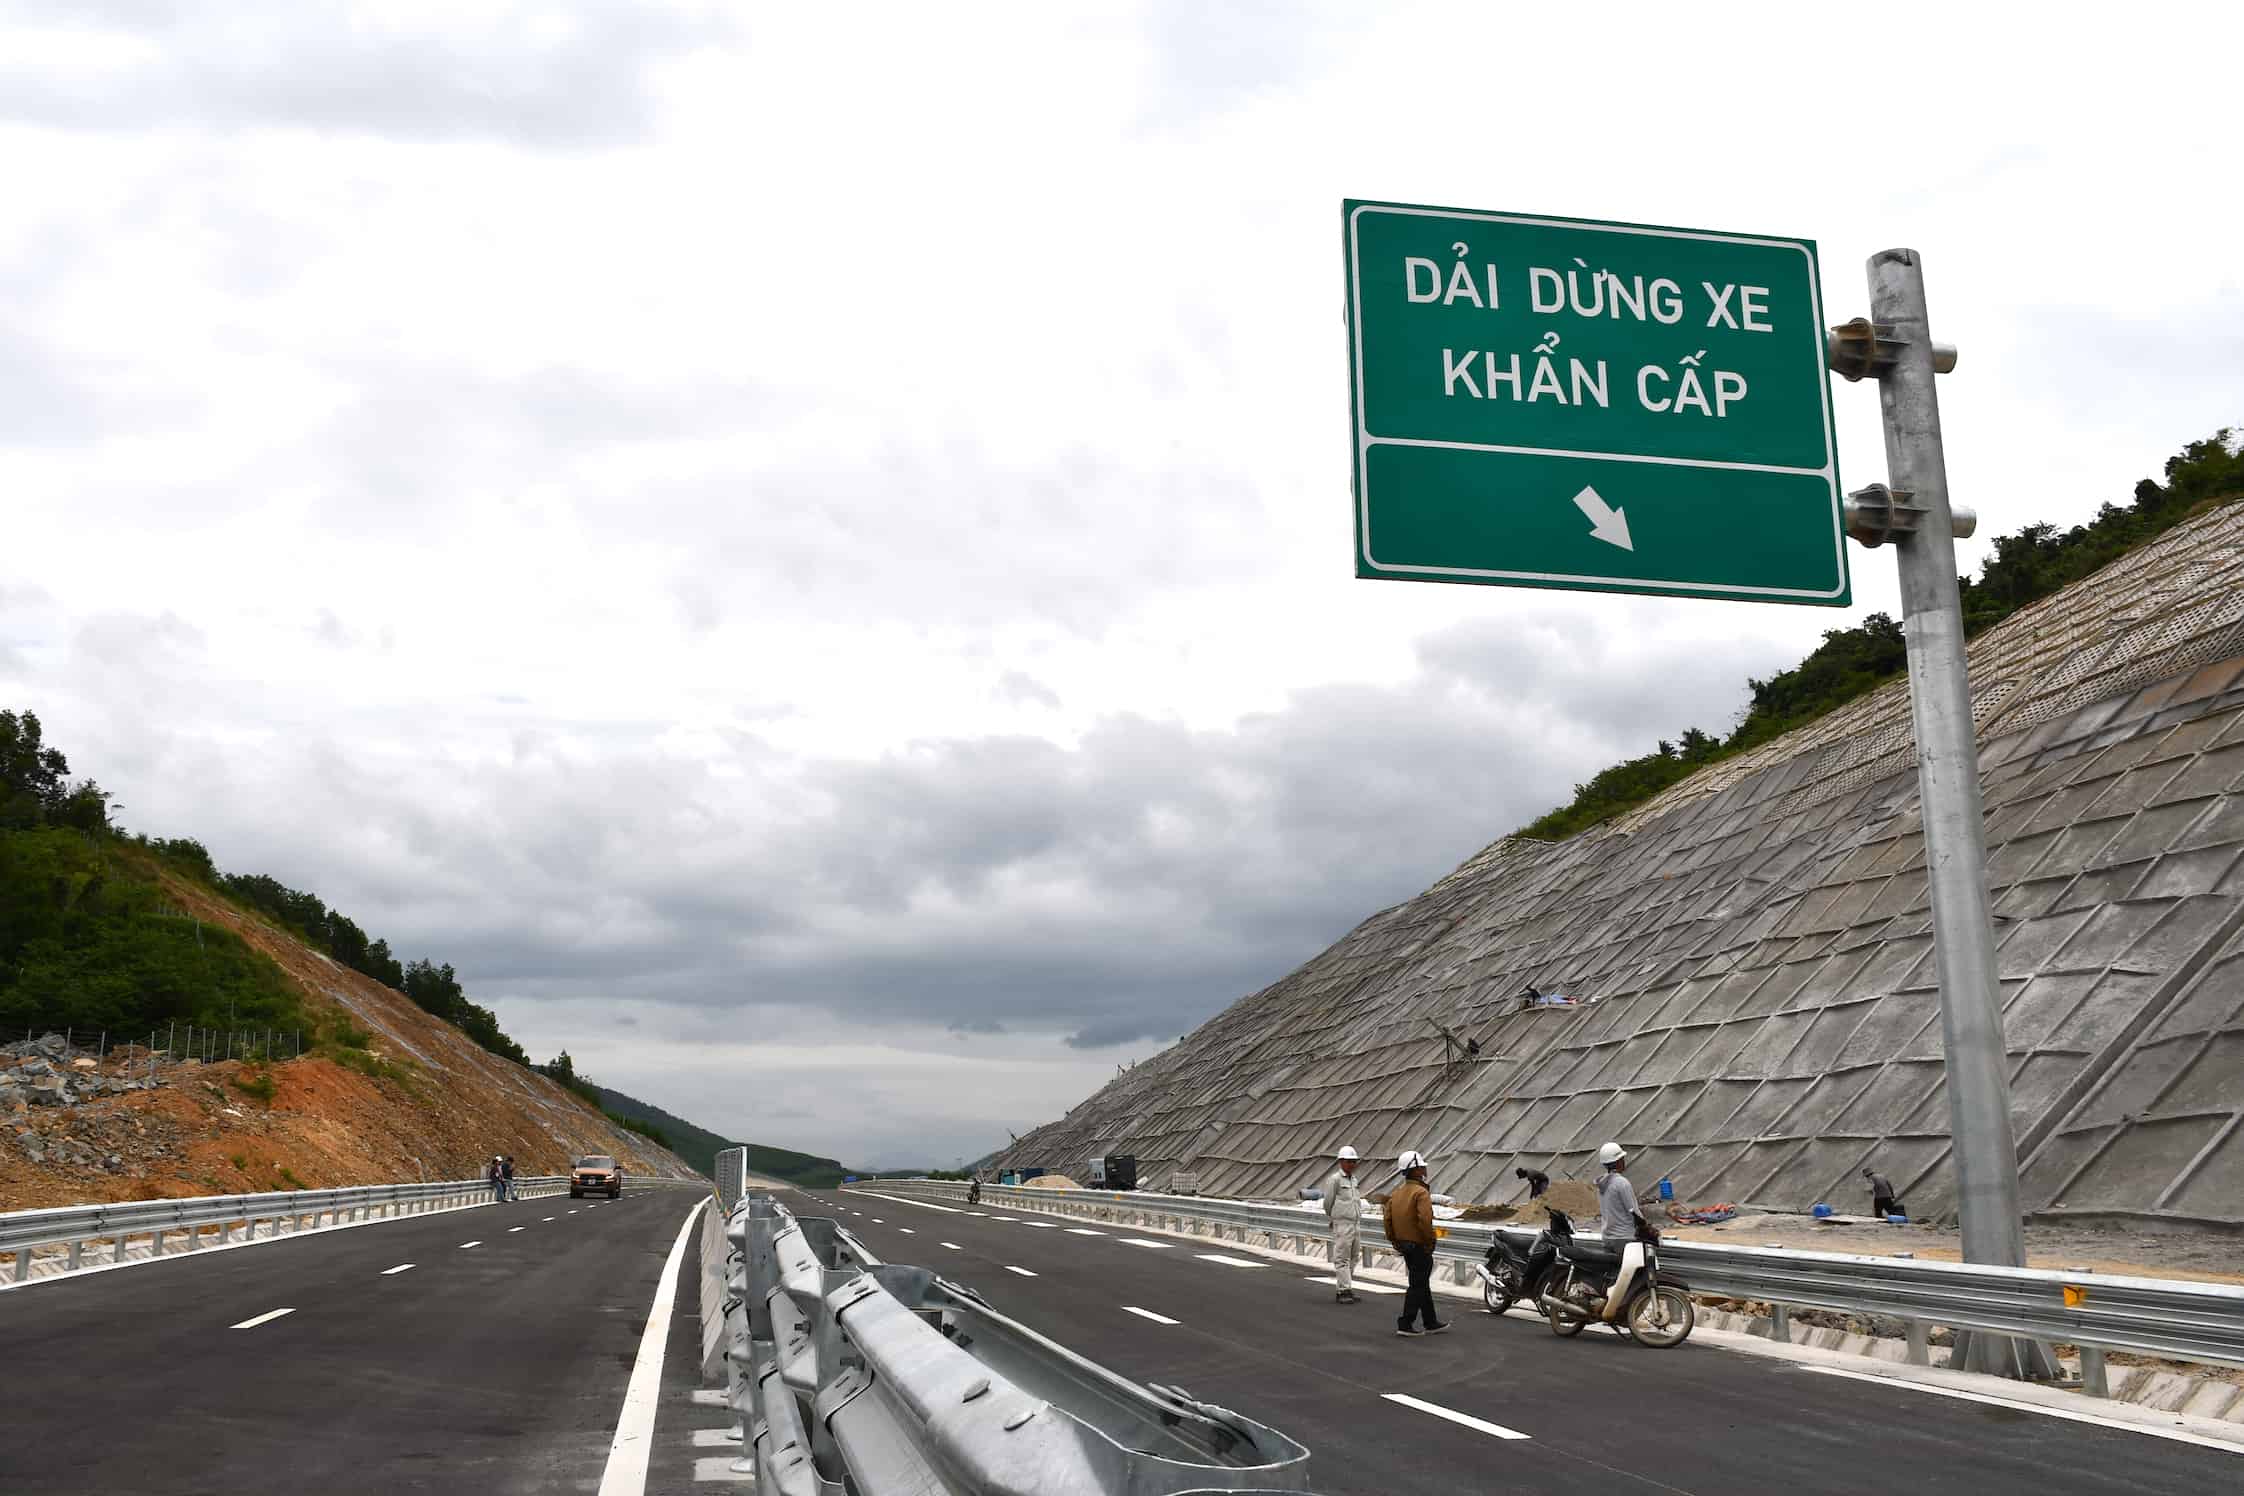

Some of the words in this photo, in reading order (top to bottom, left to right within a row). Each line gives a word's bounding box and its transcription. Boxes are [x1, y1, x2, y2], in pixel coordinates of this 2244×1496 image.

[1405, 242, 1499, 309] DẢI
[1529, 257, 1683, 324] DỪNG
[1702, 282, 1773, 332] XE
[1443, 331, 1609, 408] KHẨN
[1637, 350, 1747, 417] CẤP
